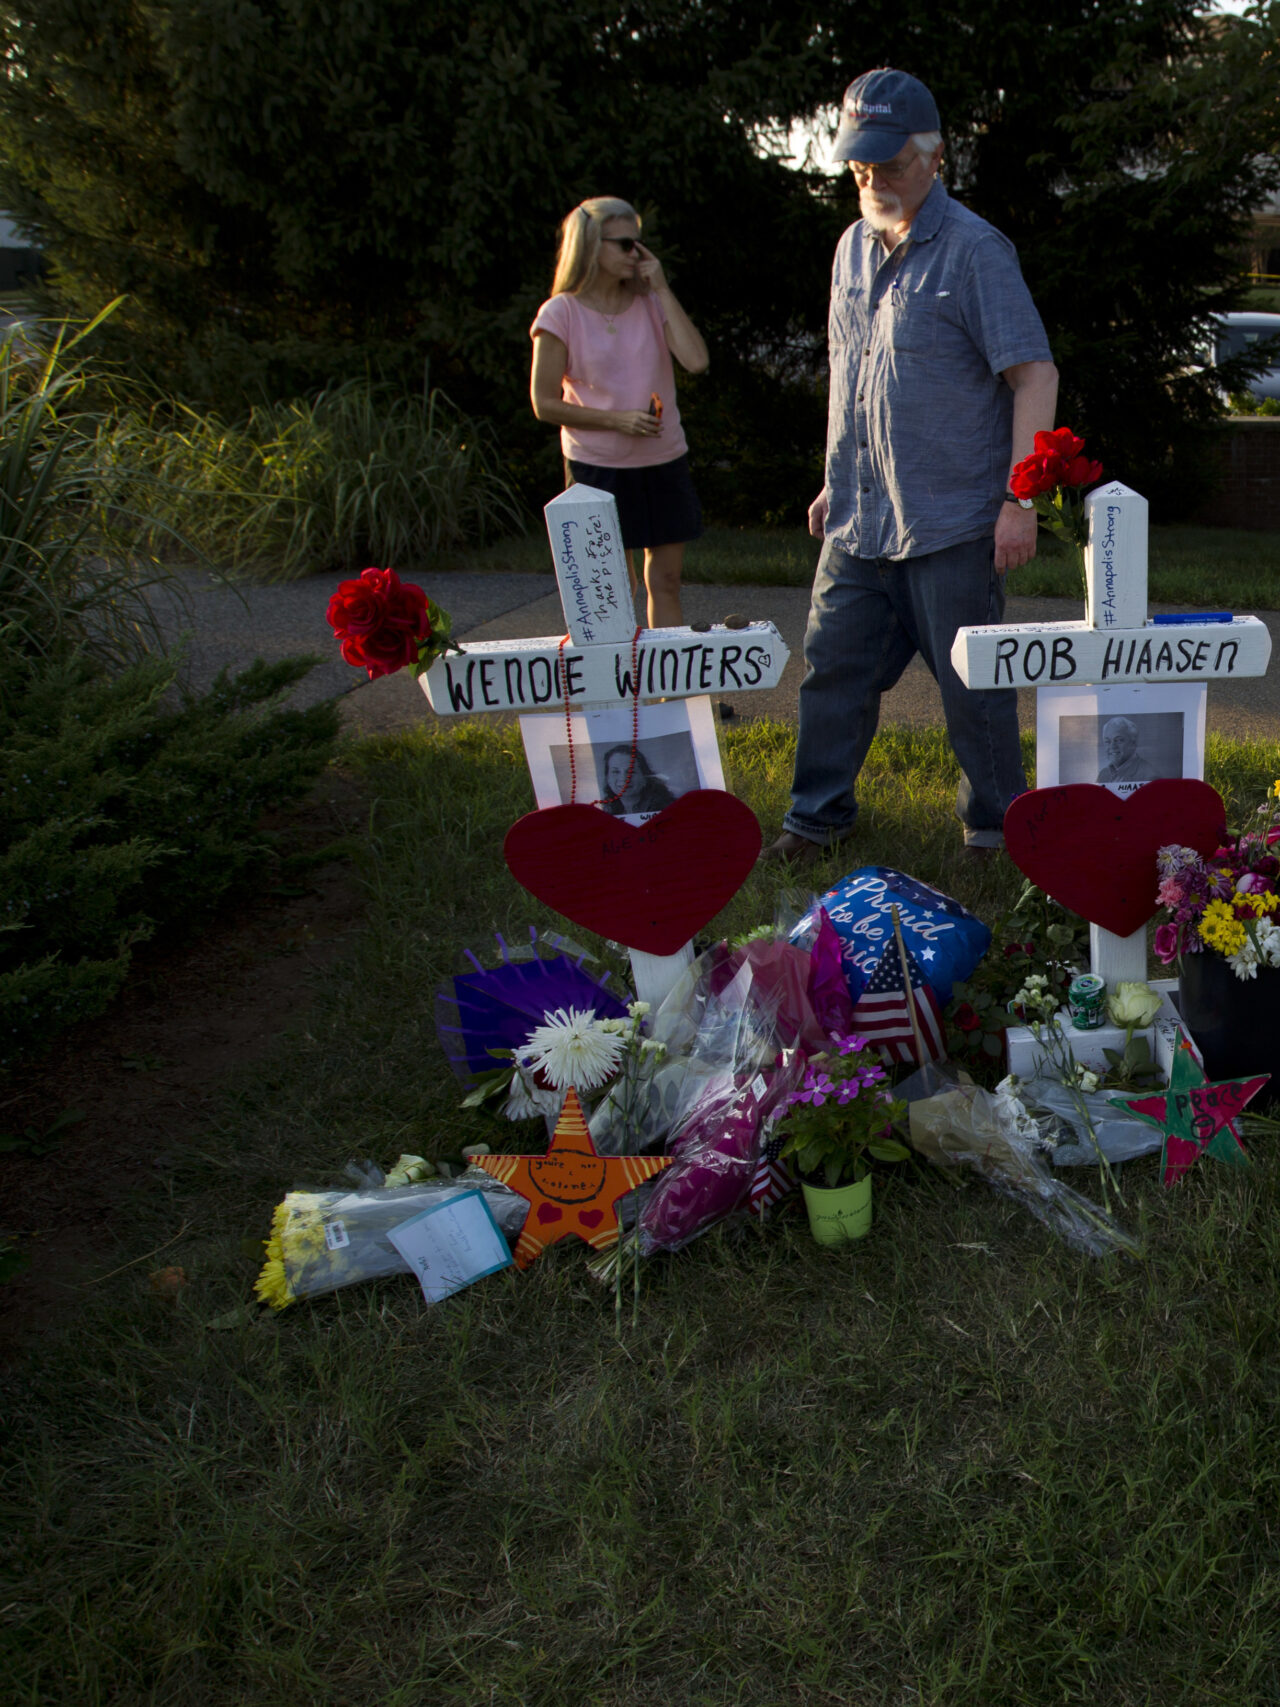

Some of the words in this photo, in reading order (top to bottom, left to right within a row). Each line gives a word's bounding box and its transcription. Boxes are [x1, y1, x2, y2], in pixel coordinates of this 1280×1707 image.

[561, 521, 596, 642] #AnnapolisStrong
[1101, 505, 1121, 627] #AnnapolisStrong
[445, 655, 586, 712] WENDIE
[615, 644, 765, 698] WINTERS
[994, 637, 1077, 685] ROB
[1101, 637, 1240, 680] HIAASEN
[827, 902, 853, 923] to
[852, 913, 884, 941] be
[845, 877, 955, 941] Proud
[1174, 1084, 1242, 1118] peace
